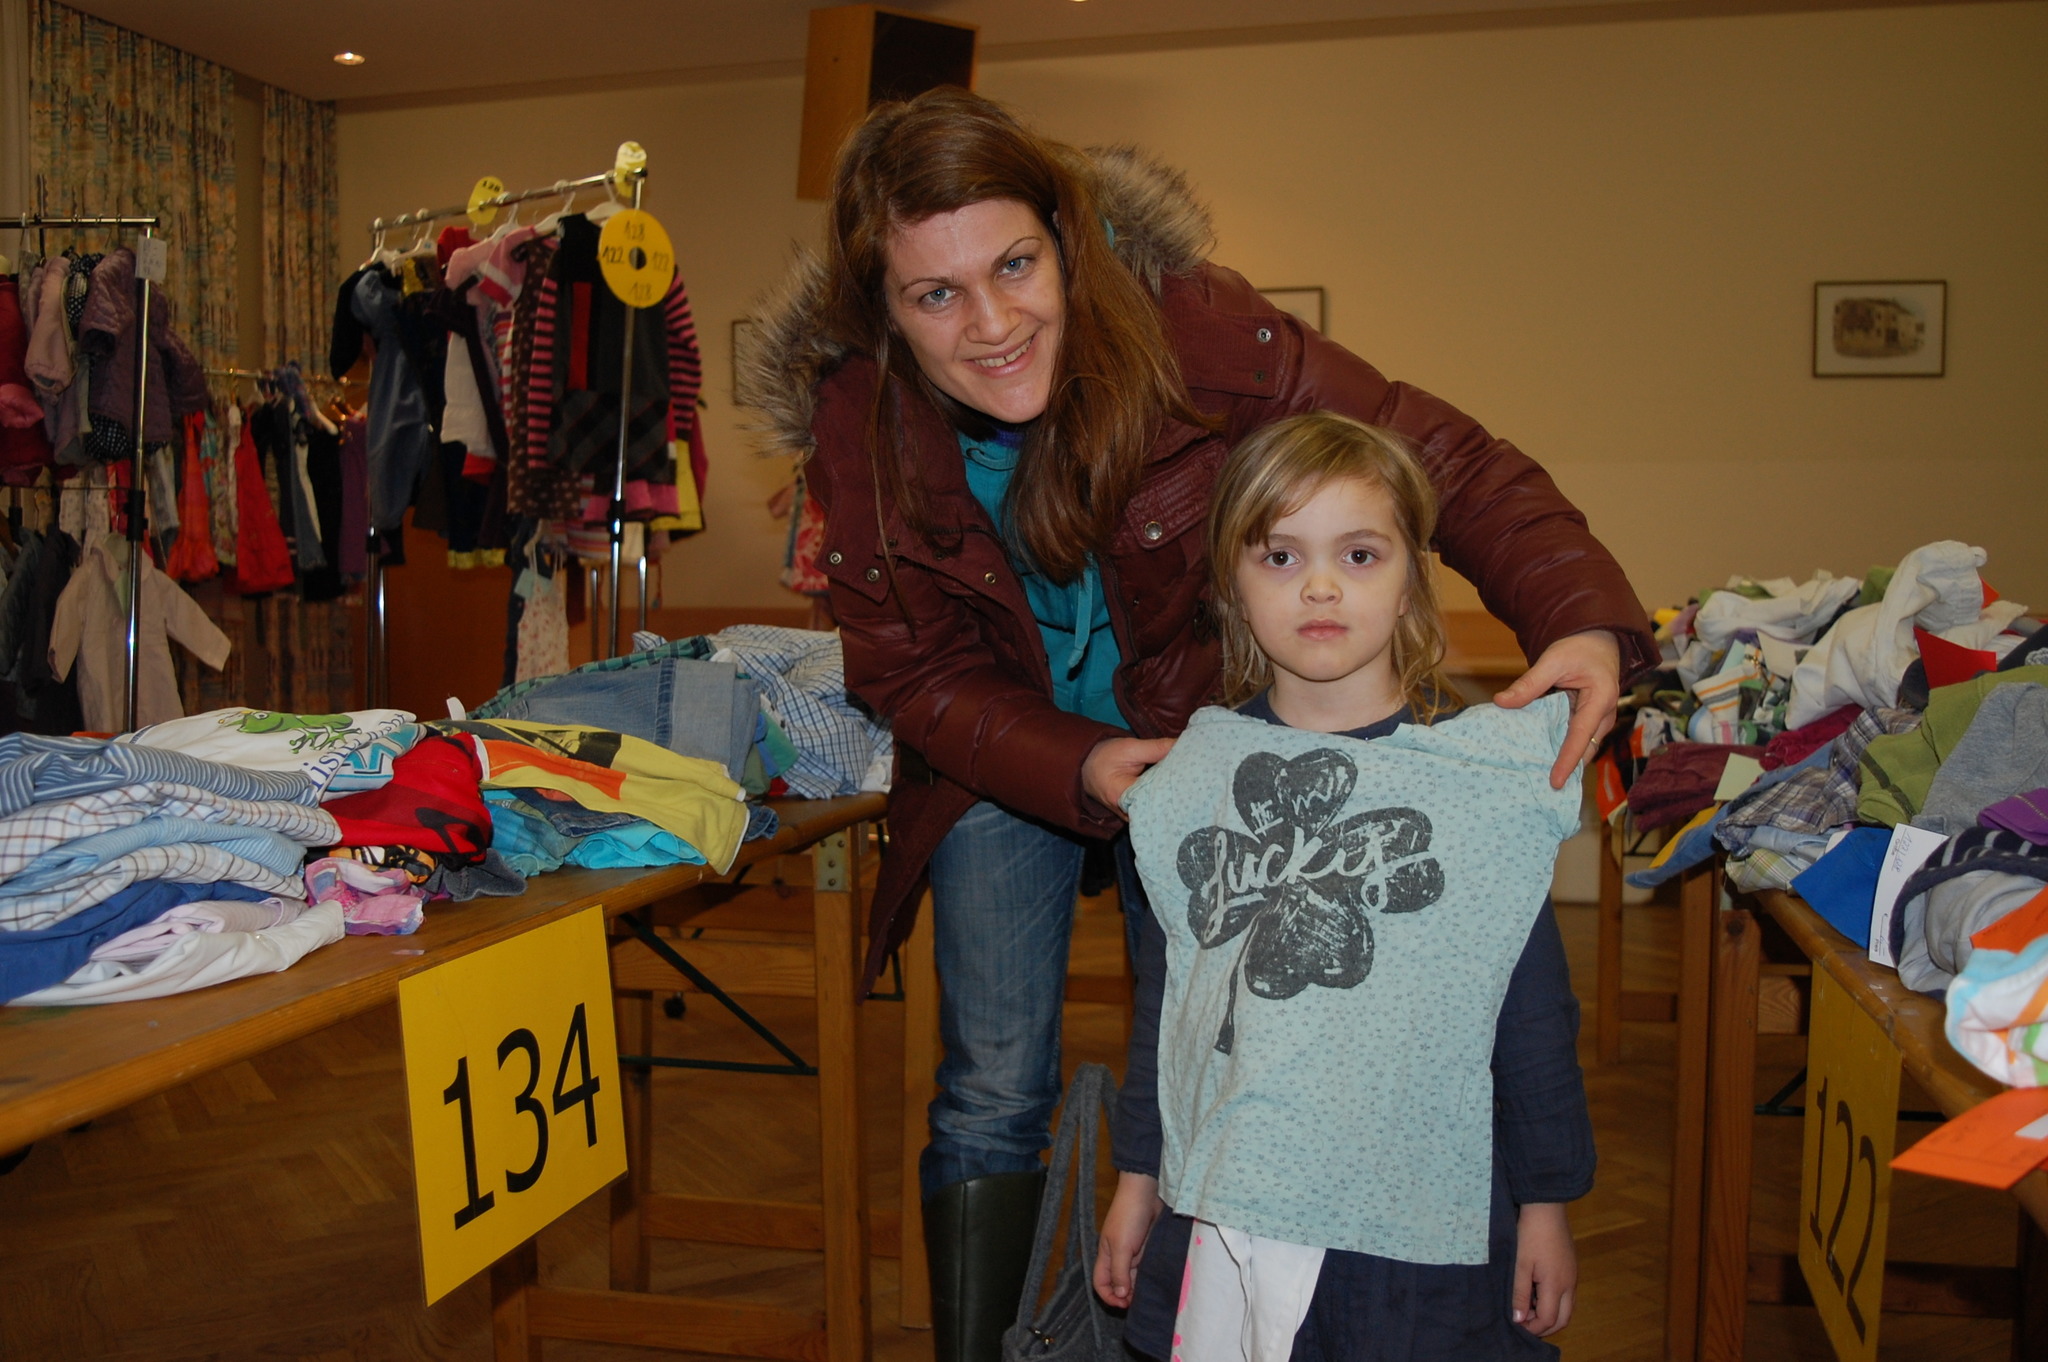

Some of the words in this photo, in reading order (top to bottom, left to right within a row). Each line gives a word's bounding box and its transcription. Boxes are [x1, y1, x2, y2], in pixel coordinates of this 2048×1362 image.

[602, 245, 625, 264] 122
[1201, 826, 1432, 943] Lucky
[443, 1002, 600, 1231] 134
[1810, 1075, 1876, 1346] 122
